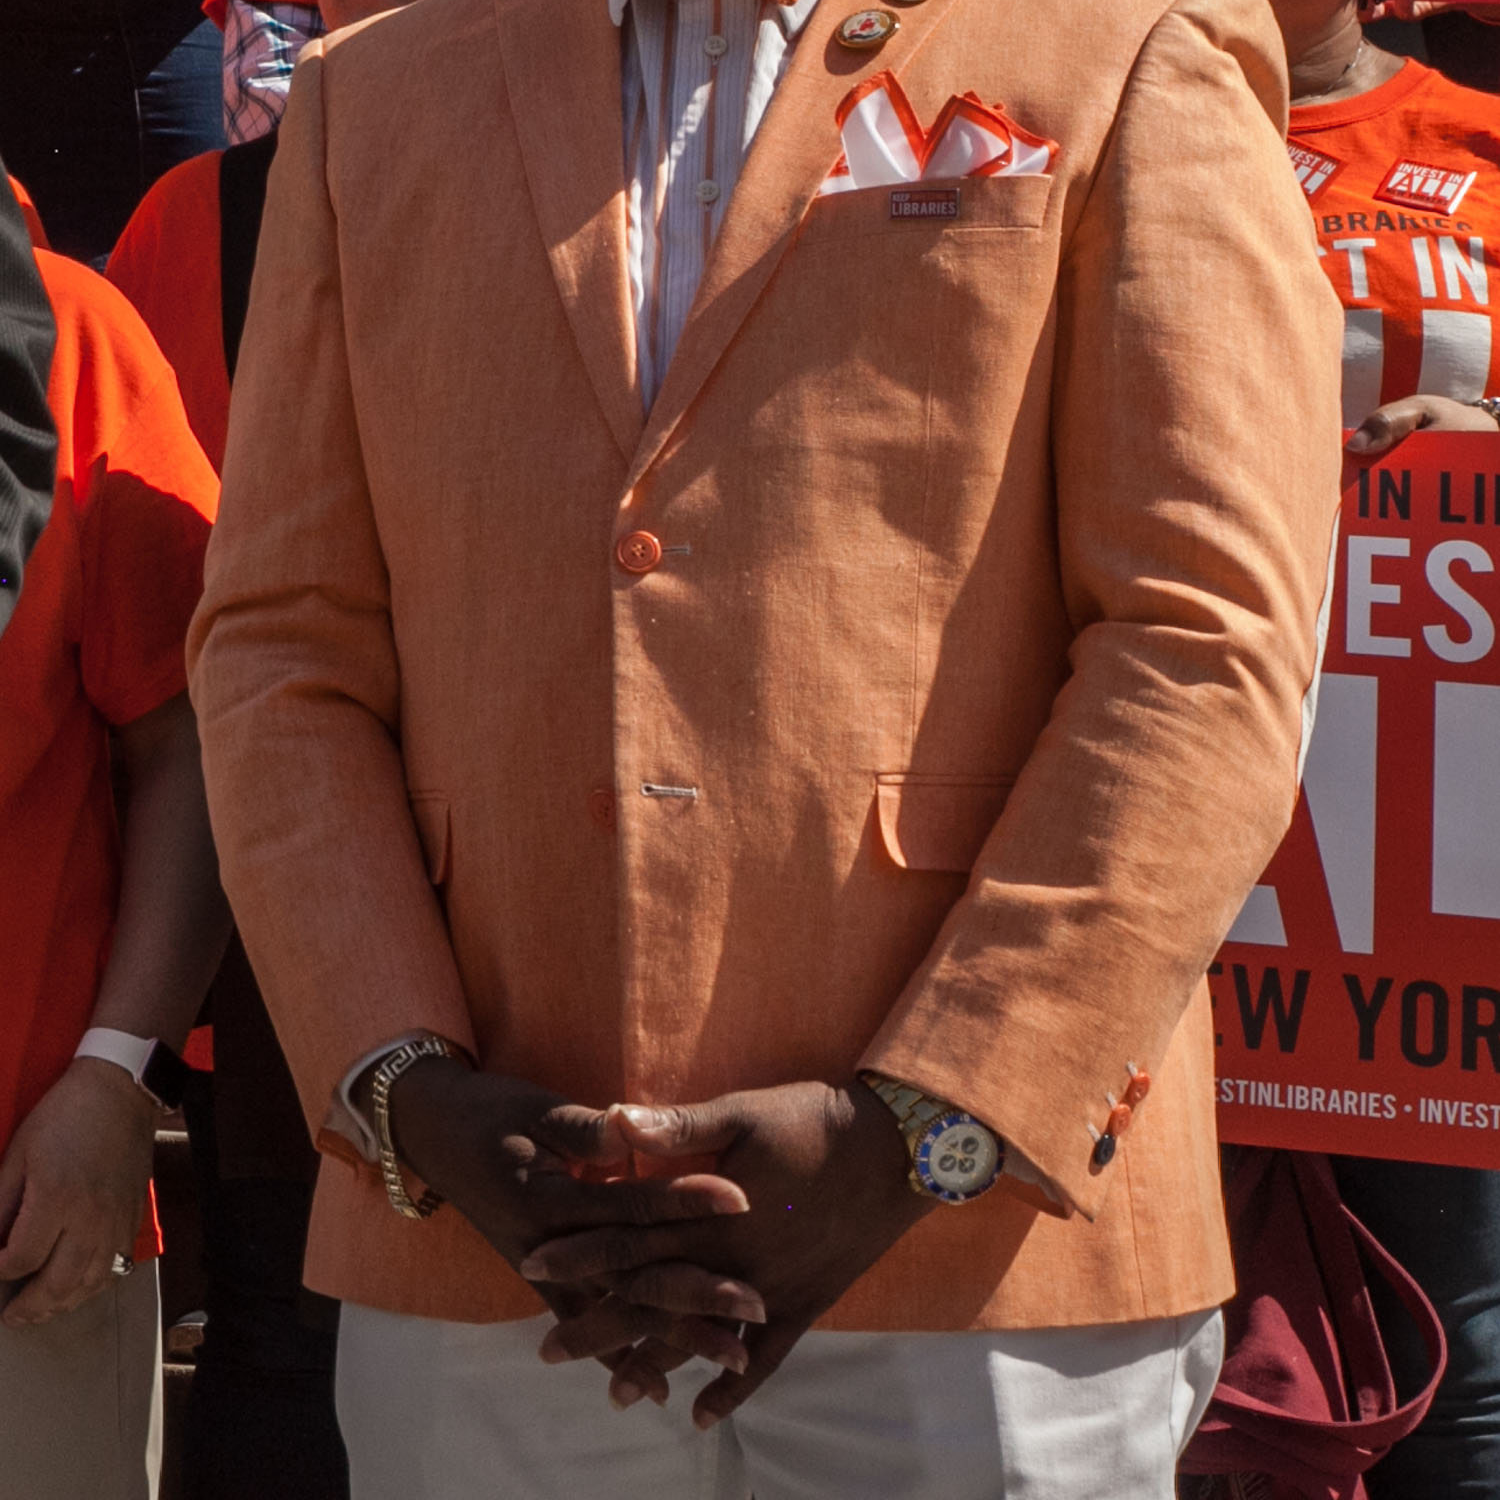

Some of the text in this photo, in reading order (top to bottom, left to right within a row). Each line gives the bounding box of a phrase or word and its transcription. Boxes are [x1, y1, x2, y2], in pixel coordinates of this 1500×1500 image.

[1387, 172, 1459, 200] ALL
[1398, 163, 1448, 183] INVEST
[1448, 173, 1465, 184] IN
[891, 202, 957, 217] LIBRARIES
[1411, 235, 1489, 305] IN
[1358, 468, 1411, 521] IN
